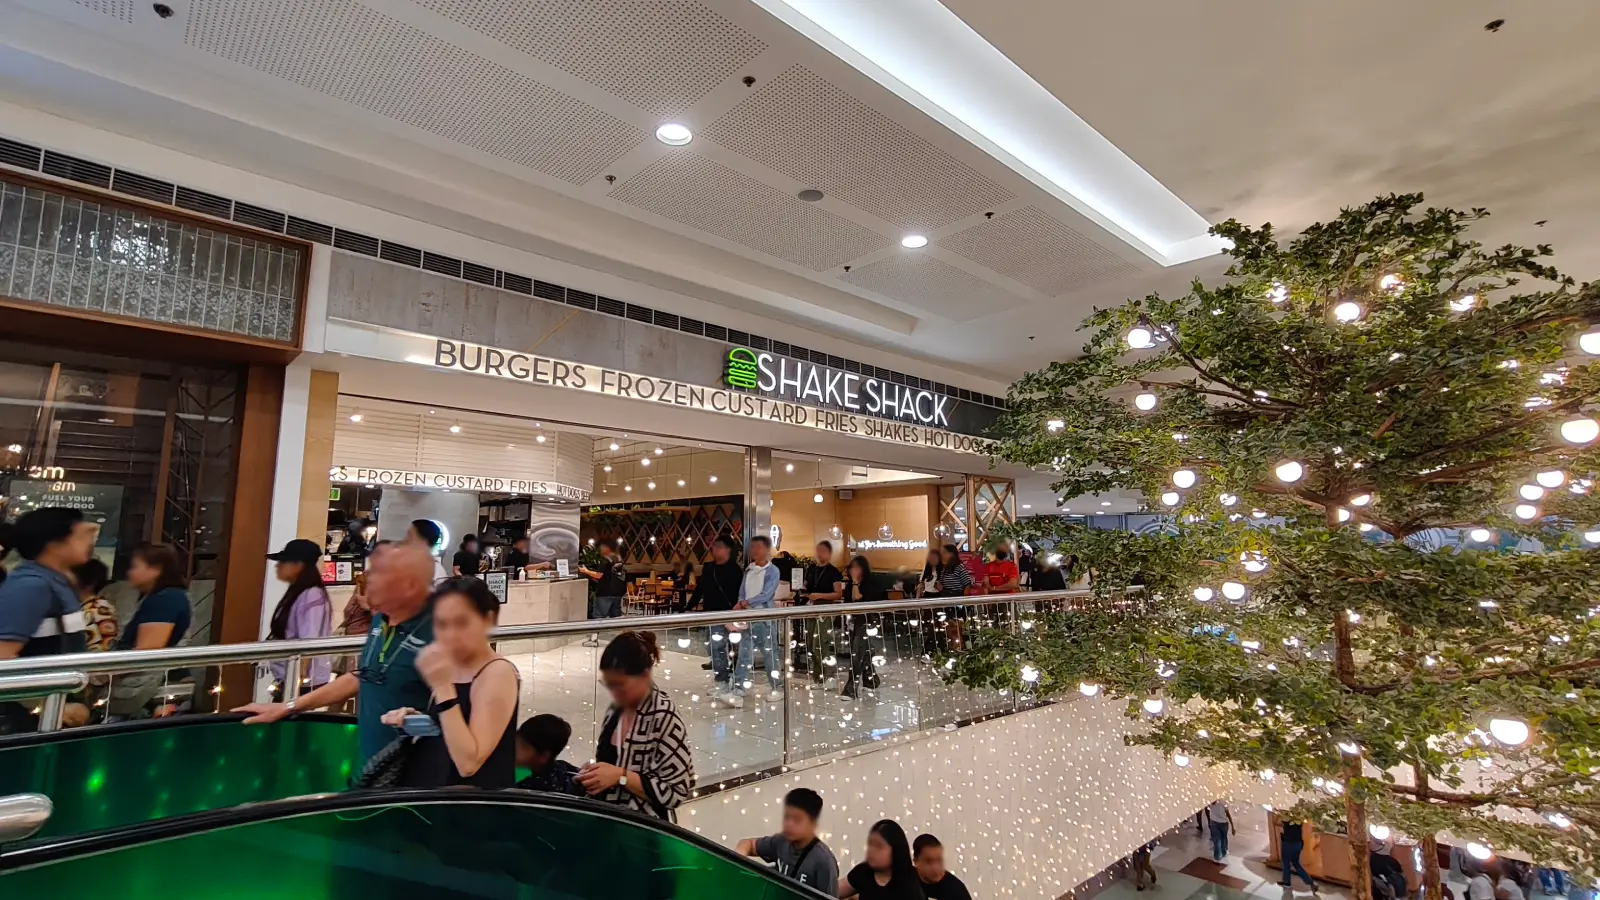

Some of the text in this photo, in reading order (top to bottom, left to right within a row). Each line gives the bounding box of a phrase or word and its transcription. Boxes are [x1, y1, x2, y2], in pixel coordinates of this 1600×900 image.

[435, 339, 586, 388] BURGERS
[601, 369, 705, 408] FROZEN
[711, 391, 808, 425] CUSTARD
[815, 410, 858, 434] FRIES
[864, 419, 918, 443] SHAKES
[924, 428, 951, 448] HOT
[757, 352, 949, 426] SHAKE SHACK
[68, 495, 94, 503] YOUR
[357, 469, 427, 485] FROZEN
[433, 474, 504, 491] CUSTARD
[510, 480, 547, 494] FRIES
